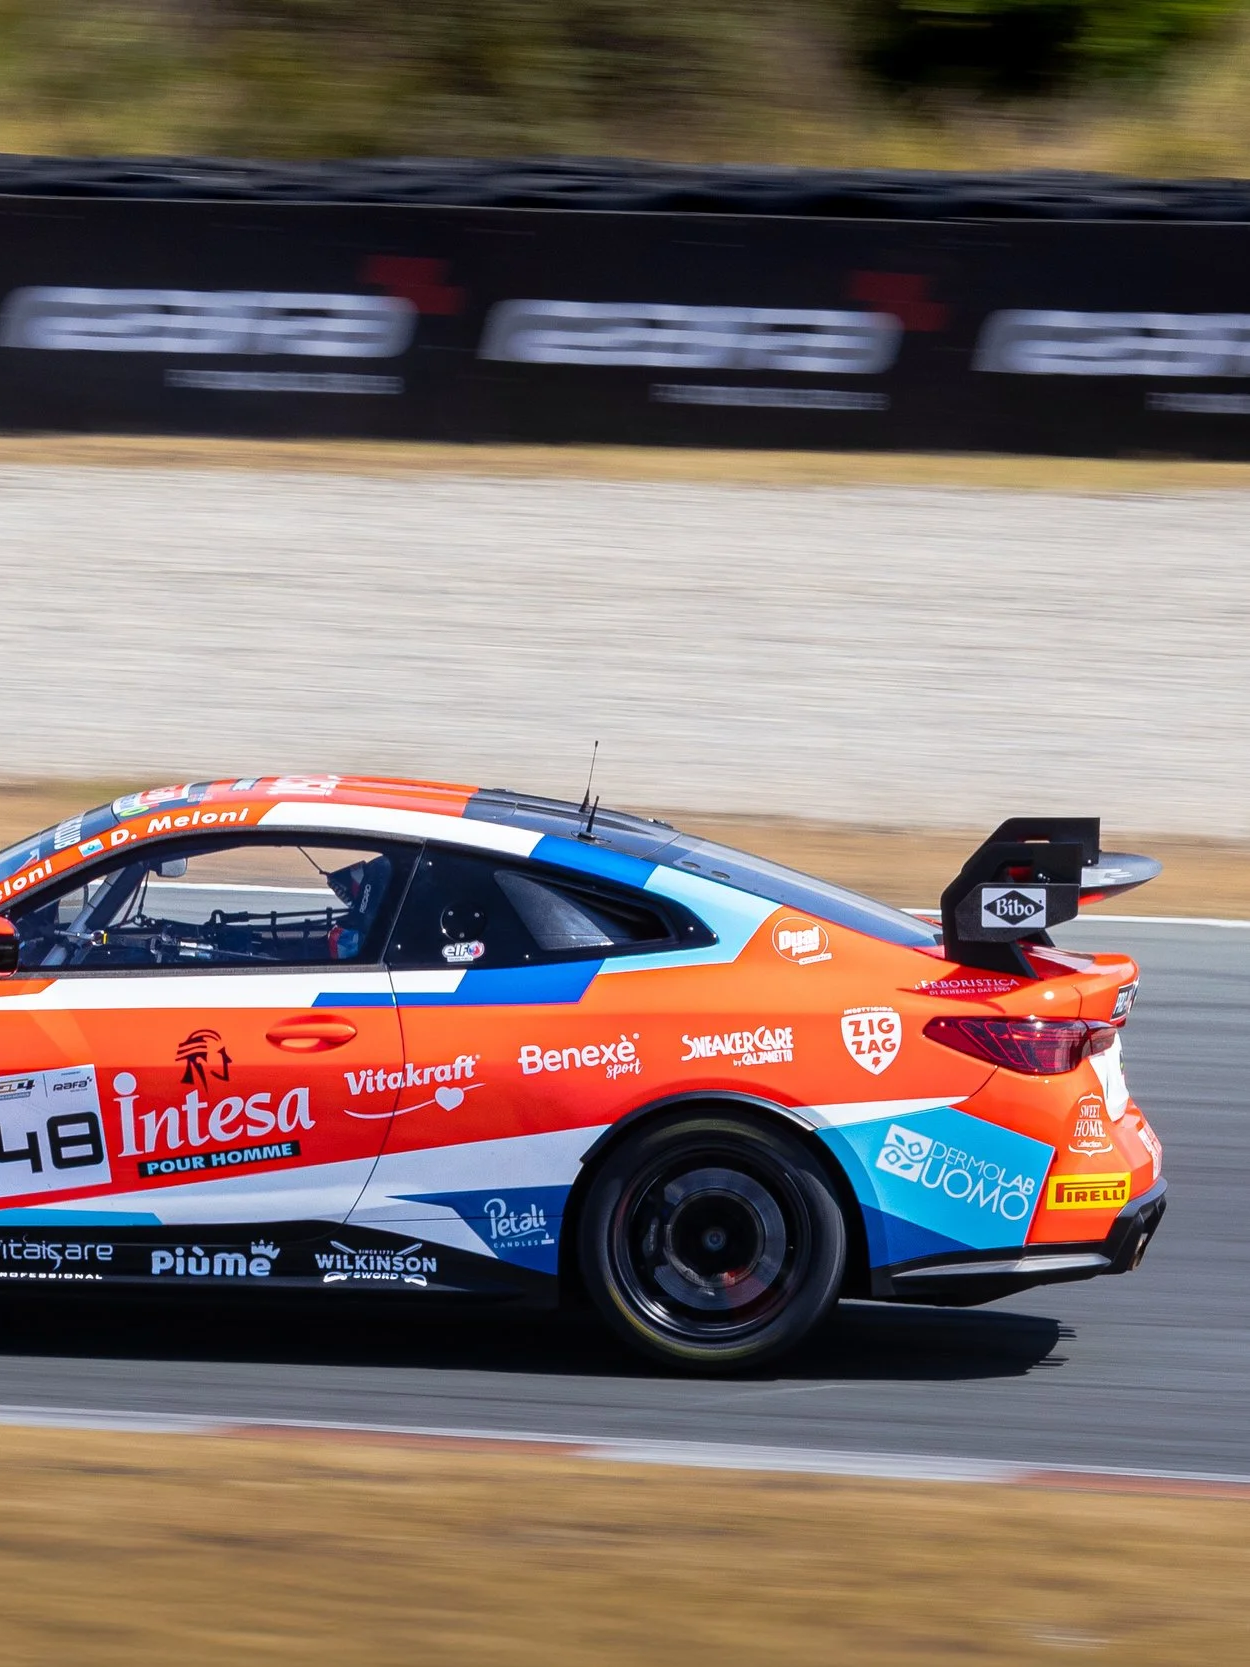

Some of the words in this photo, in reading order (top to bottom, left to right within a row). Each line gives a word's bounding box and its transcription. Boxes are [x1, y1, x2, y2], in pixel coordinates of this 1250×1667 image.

[110, 828, 137, 847] D.
[147, 808, 249, 833] Meloni
[996, 898, 1035, 916] Bibo
[443, 943, 469, 957] elf
[849, 1018, 895, 1037] ZIG
[517, 1034, 636, 1075] Benexè
[851, 1038, 897, 1055] ZAG
[343, 1055, 477, 1095] Vitakraft
[606, 1058, 643, 1080] sport
[1079, 1104, 1101, 1118] SWEET
[1073, 1120, 1106, 1138] HOME
[147, 1156, 205, 1175] POUR
[212, 1143, 293, 1166] HOMME
[930, 1140, 1035, 1196] DERMOLAB
[920, 1157, 1029, 1220] UOMO
[1055, 1180, 1126, 1203] PIRELLI
[484, 1198, 547, 1240] Petali
[493, 1240, 538, 1249] CANDLES
[151, 1245, 272, 1276] Piùme
[314, 1253, 437, 1273] WILKINSON
[352, 1271, 399, 1281] SWORD
